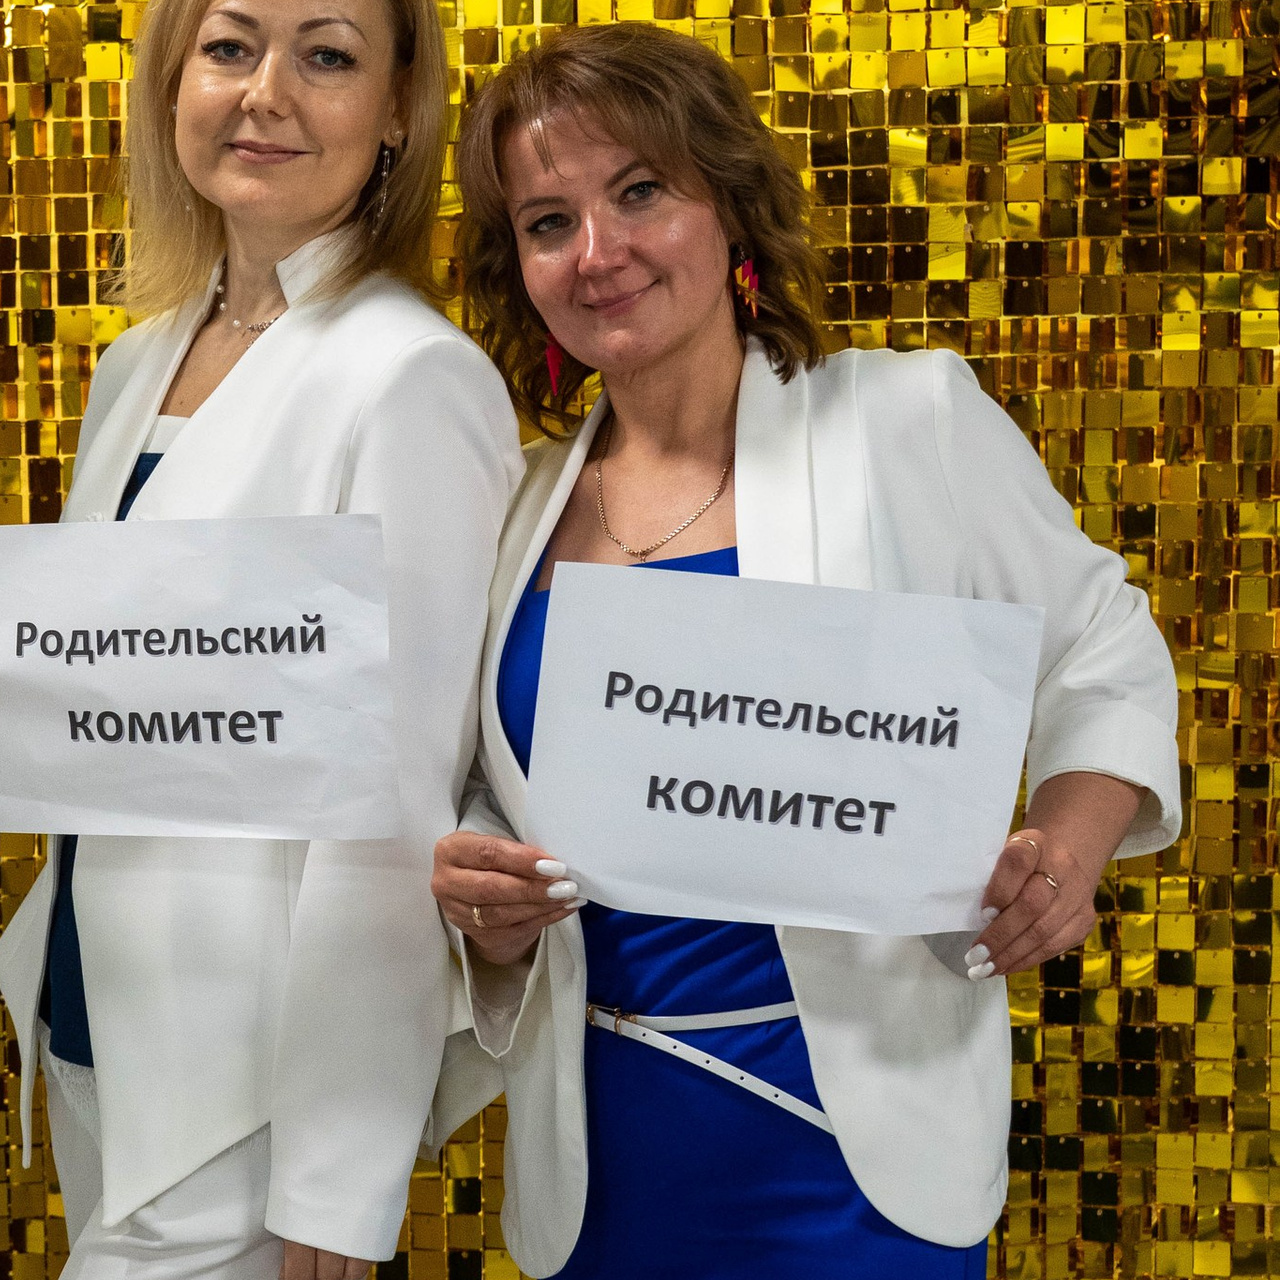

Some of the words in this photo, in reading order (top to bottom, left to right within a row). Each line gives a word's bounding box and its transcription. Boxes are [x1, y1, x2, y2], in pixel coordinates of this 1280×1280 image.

[16, 613, 326, 666] Родительский
[67, 710, 284, 744] комитет
[603, 671, 961, 750] Родительский
[646, 775, 898, 837] комитет
